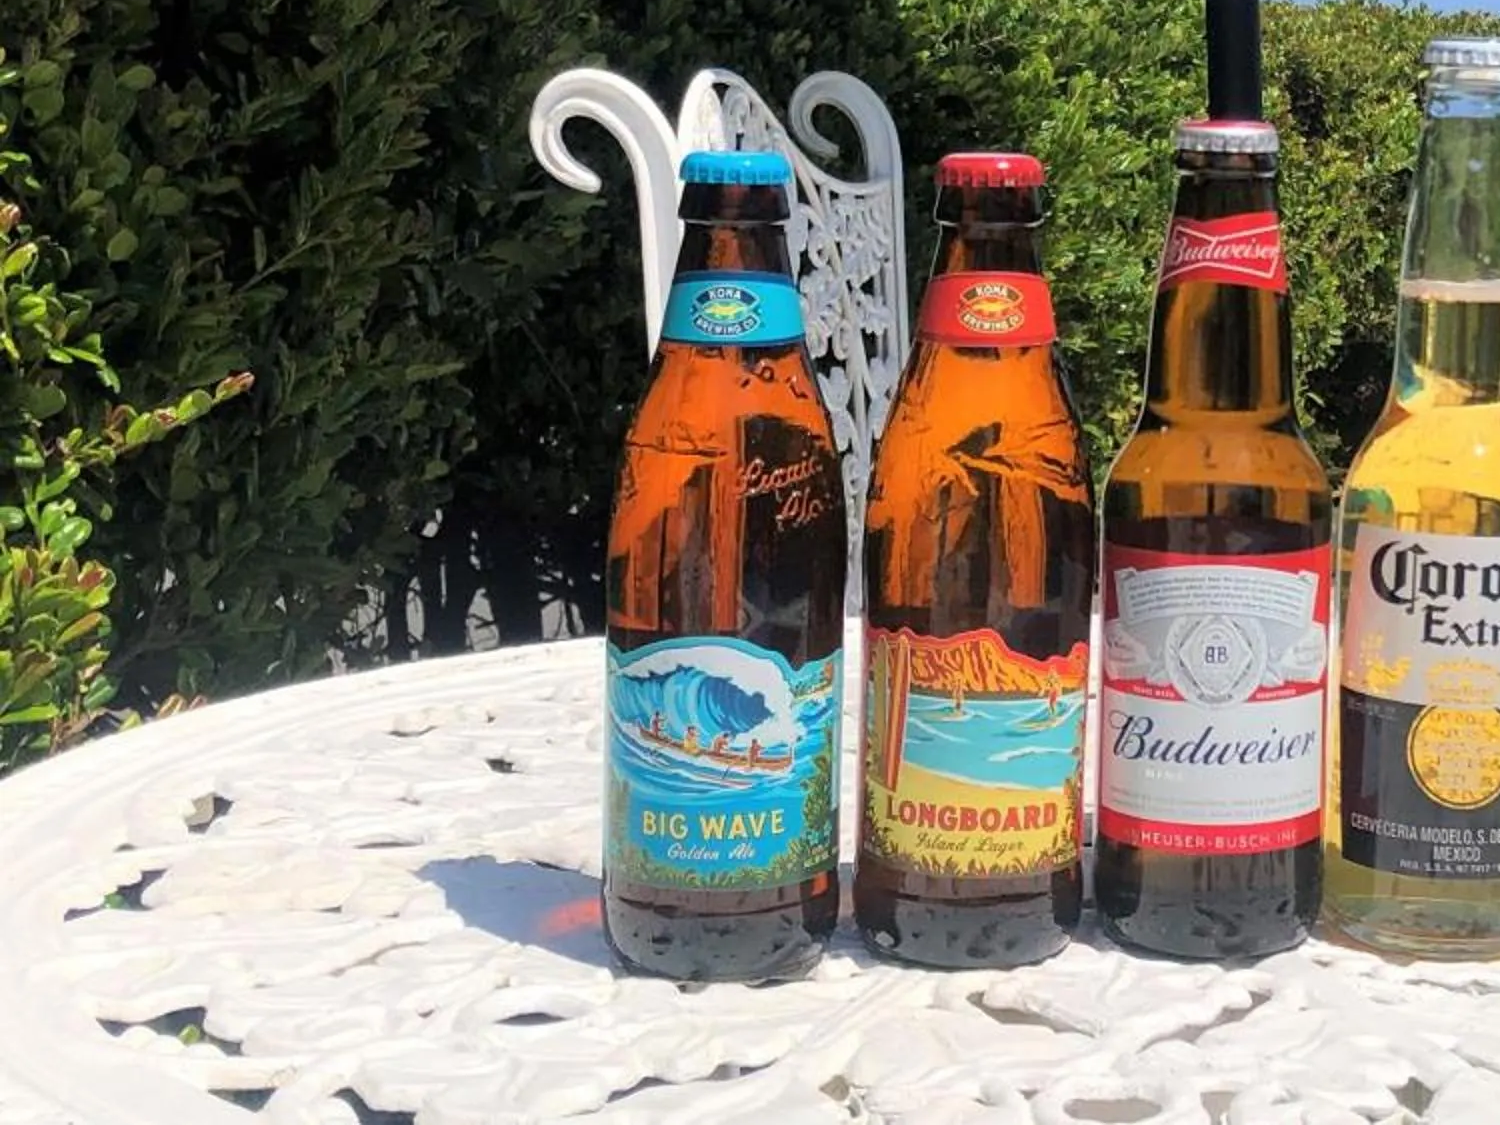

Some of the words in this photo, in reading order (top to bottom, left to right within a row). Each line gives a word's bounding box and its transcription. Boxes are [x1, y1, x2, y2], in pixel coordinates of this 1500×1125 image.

[708, 288, 742, 300] KONA
[975, 286, 1008, 296] KONA
[695, 317, 743, 336] BREWING
[1109, 710, 1316, 766] Budweiser
[885, 793, 1059, 833] LONGBOARD
[642, 810, 689, 839] BIG
[699, 808, 786, 840] WAVE
[667, 842, 719, 860] Golden
[728, 842, 757, 860] Ale
[916, 833, 968, 852] Island
[973, 837, 1025, 857] Lager
[1433, 846, 1482, 862] MEXICO
